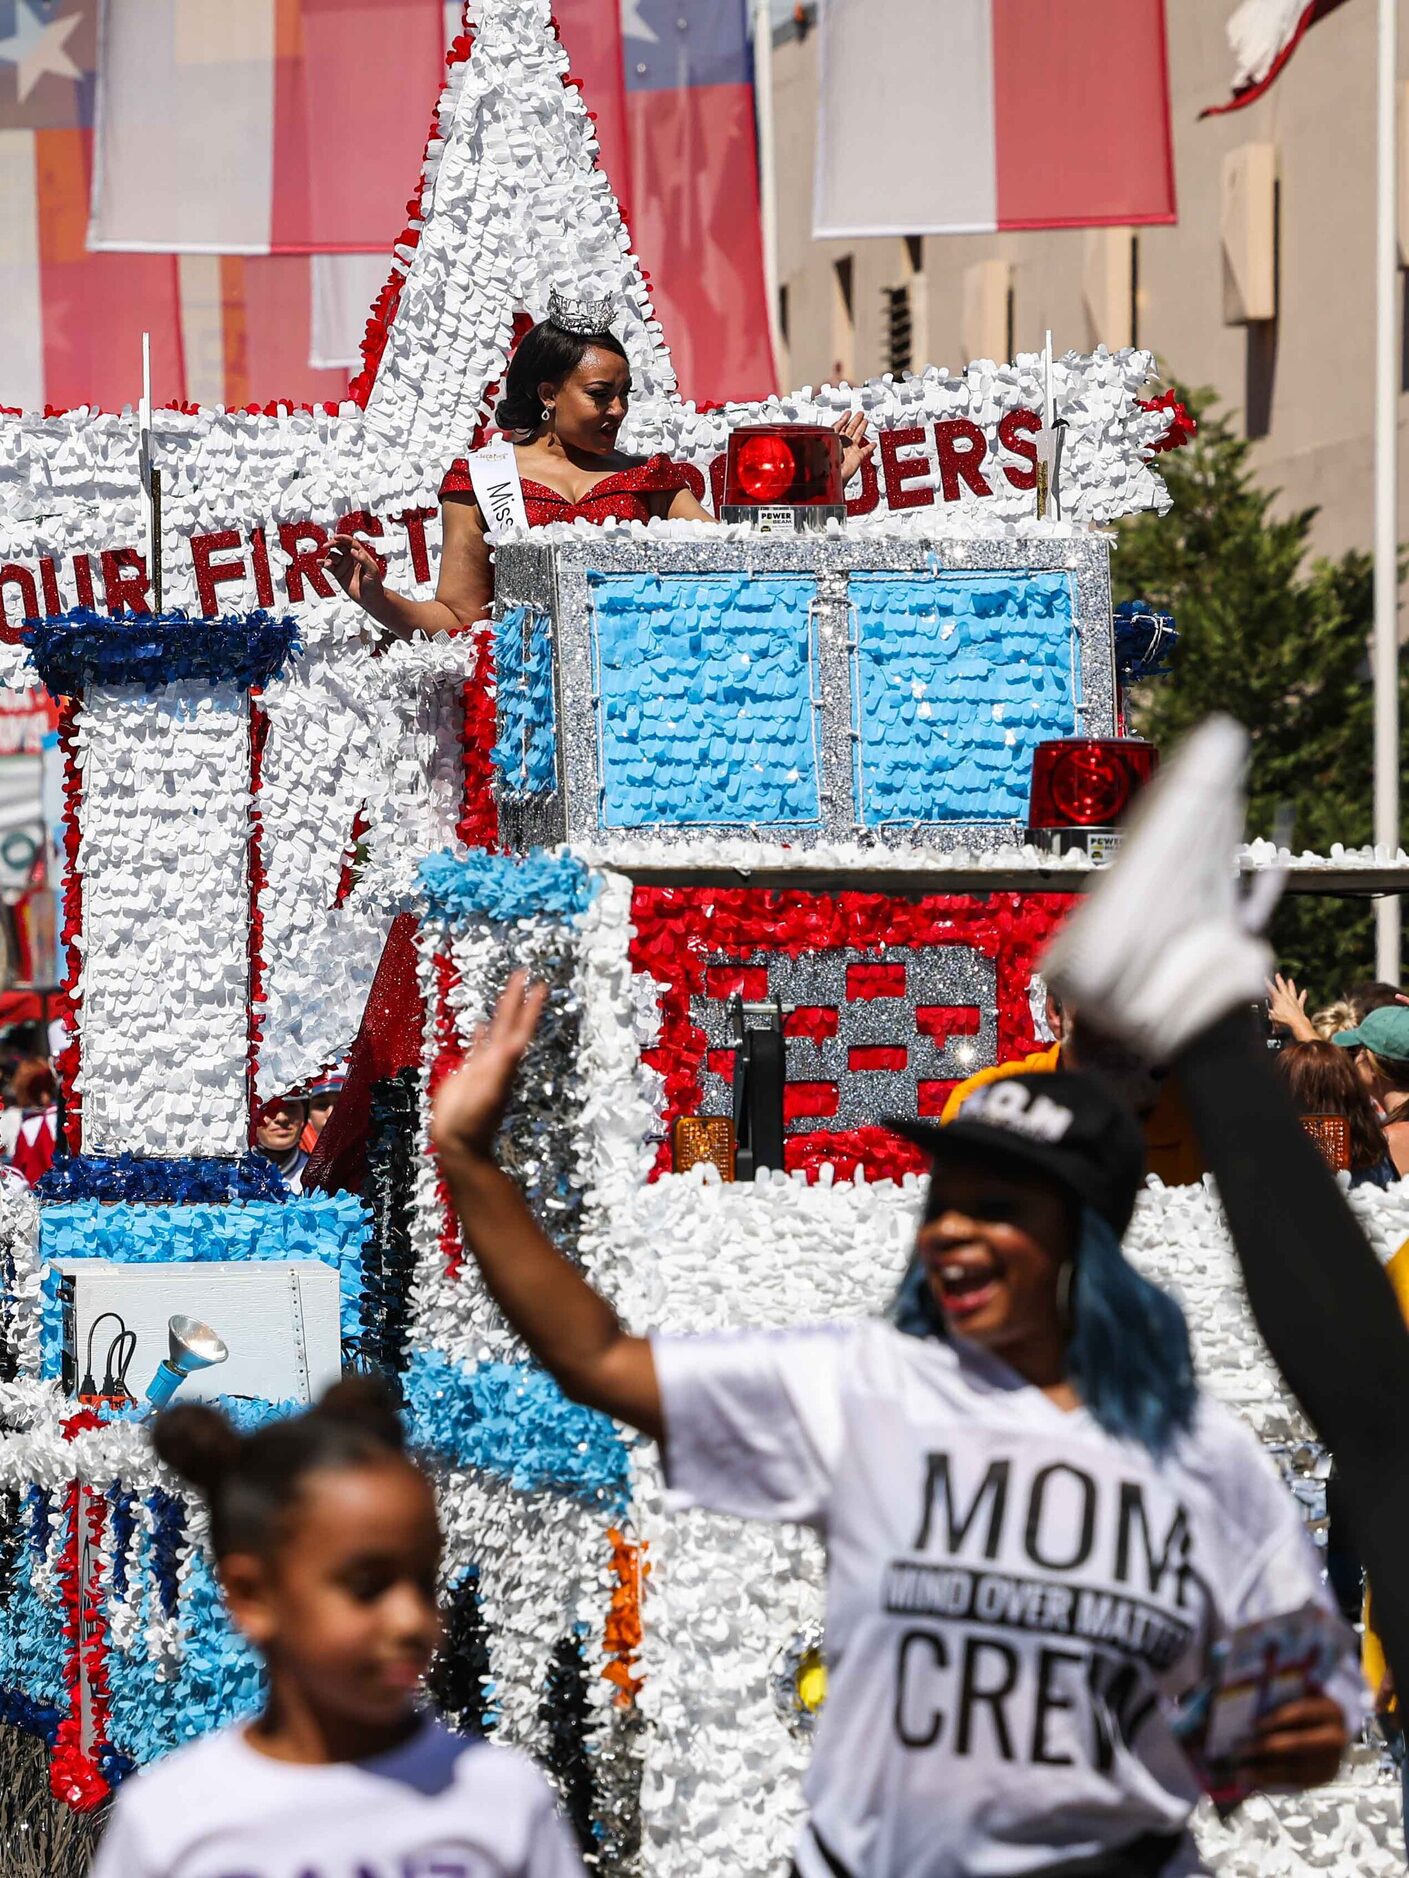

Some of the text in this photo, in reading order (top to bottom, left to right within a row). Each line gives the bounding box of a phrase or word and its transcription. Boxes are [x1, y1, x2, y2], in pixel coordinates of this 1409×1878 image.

[487, 481, 515, 530] Miss
[189, 507, 438, 617] FIRST
[913, 1452, 1192, 1607] MOM
[976, 1575, 1073, 1631] OVER
